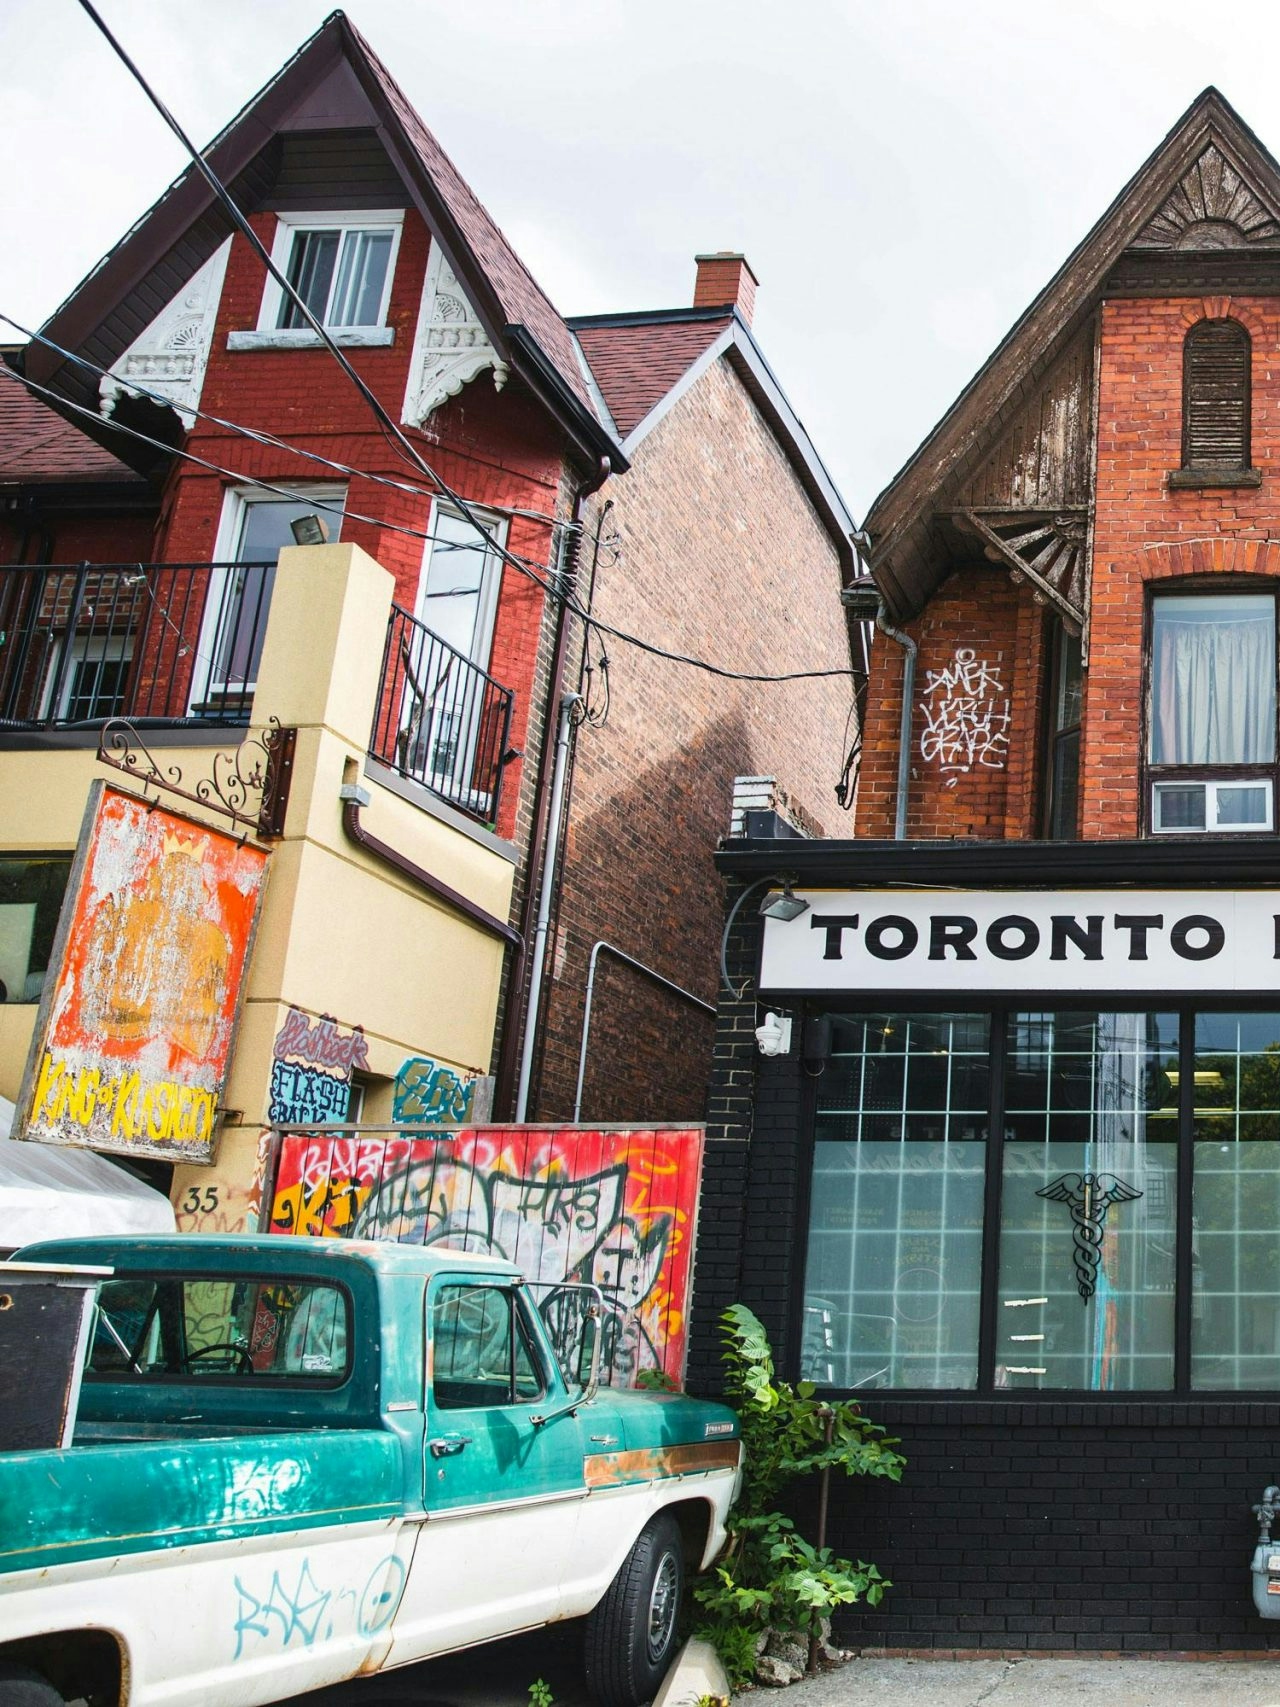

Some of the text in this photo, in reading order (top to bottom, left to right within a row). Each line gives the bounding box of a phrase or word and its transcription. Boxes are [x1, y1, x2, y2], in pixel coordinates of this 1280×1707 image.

[810, 913, 1225, 961] TORONTO
[277, 1065, 348, 1117] FLASH
[183, 1187, 219, 1214] 35
